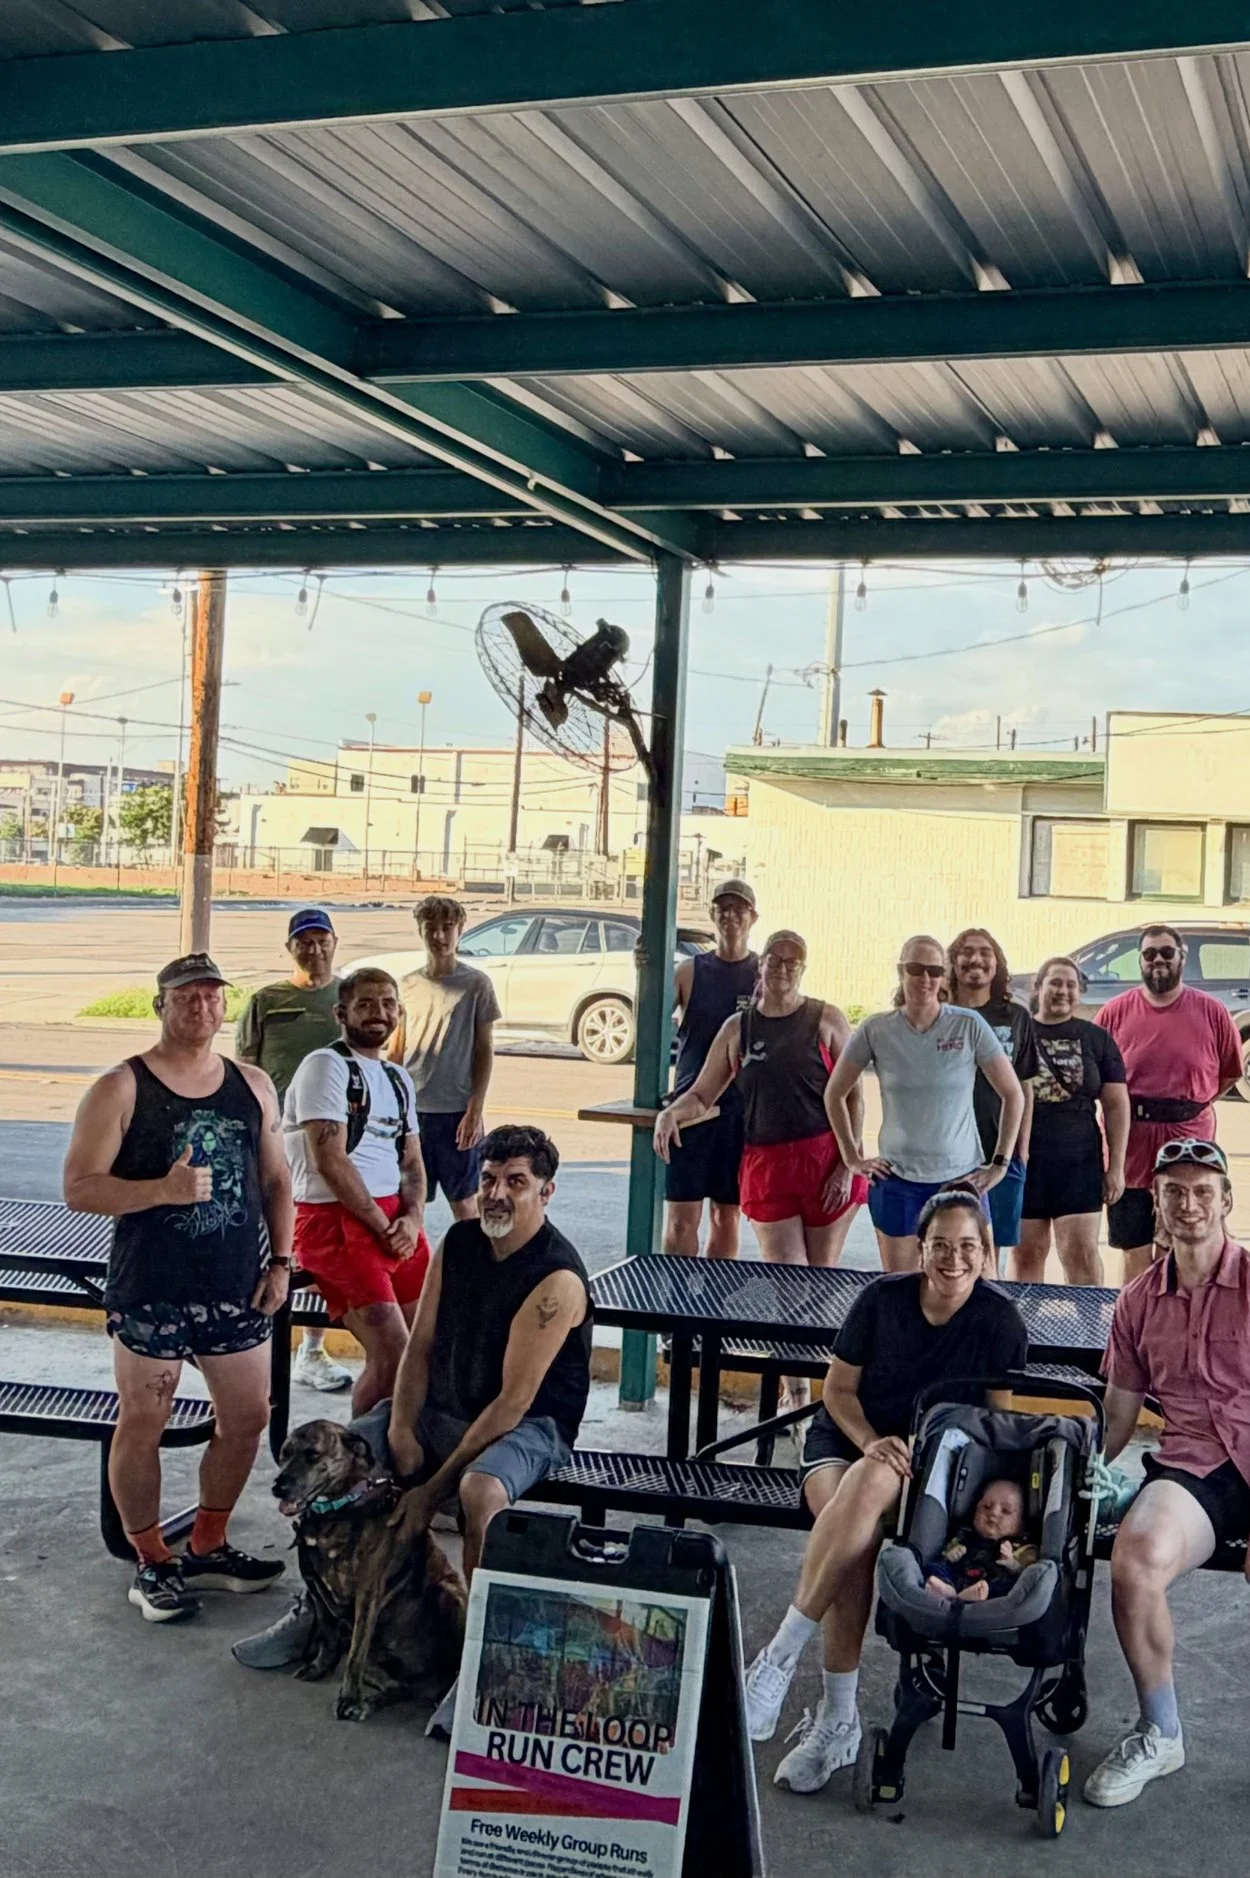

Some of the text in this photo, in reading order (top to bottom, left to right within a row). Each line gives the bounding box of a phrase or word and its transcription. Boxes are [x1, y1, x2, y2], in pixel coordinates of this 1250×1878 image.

[477, 1696, 672, 1752] IN THE LOOP
[487, 1731, 656, 1785] RUN CREW
[470, 1818, 503, 1838] Free
[505, 1823, 560, 1850] Weekly
[561, 1835, 608, 1858] Group
[610, 1843, 648, 1864] Runs
